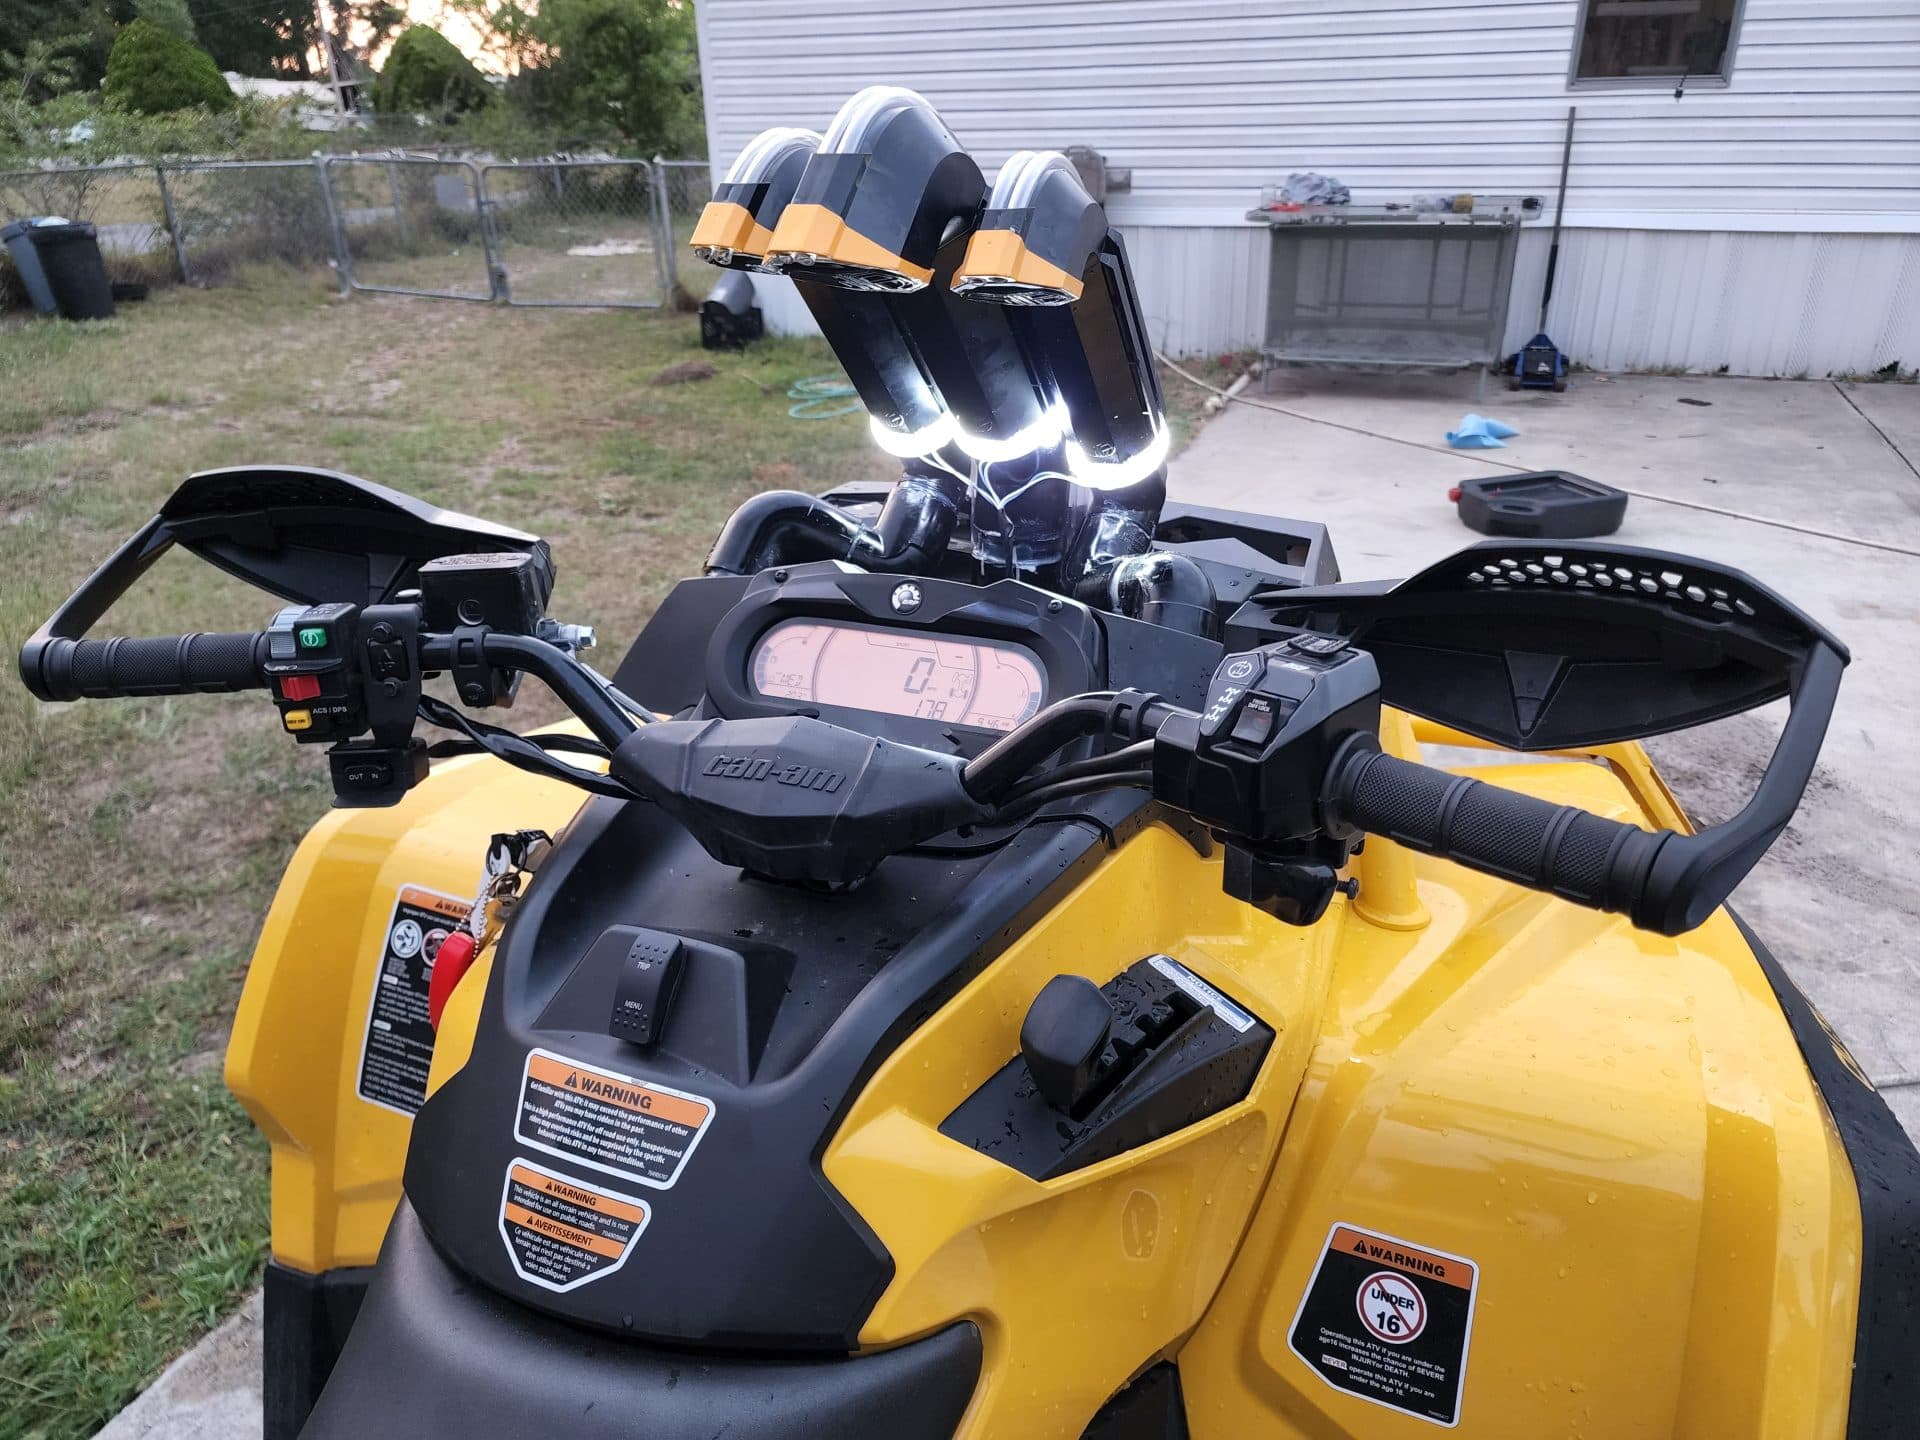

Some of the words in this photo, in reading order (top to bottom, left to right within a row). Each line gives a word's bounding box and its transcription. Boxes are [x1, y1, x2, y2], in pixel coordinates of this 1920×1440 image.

[904, 656, 936, 694] 0
[702, 754, 846, 793] can-am
[624, 999, 643, 1011] MENU
[582, 1078, 651, 1109] WARNING
[588, 1102, 600, 1111] may
[600, 1106, 618, 1116] exceed
[618, 1110, 628, 1119] the
[628, 1115, 664, 1129] performance
[672, 1127, 688, 1136] other
[621, 1122, 631, 1130] the
[572, 1140, 582, 1148] ATV
[577, 1121, 588, 1129] ATV
[603, 1129, 616, 1139] road
[616, 1134, 626, 1142] use
[641, 1140, 682, 1160] Inexperienced
[600, 1140, 626, 1152] surprised
[633, 1149, 643, 1157] the
[644, 1153, 665, 1163] specific
[554, 1185, 596, 1206] WARNING
[535, 1220, 592, 1245] AVERTISSEMENT
[578, 1211, 598, 1221] vehicle
[617, 1223, 629, 1231] not
[515, 1227, 521, 1235] Ce
[584, 1254, 597, 1263] tout
[1371, 1246, 1444, 1276] WARNING
[1371, 1288, 1415, 1311] UNDER
[1376, 1312, 1401, 1334] 16
[1321, 1327, 1351, 1343] Operating
[1366, 1343, 1380, 1351] ATV
[1414, 1359, 1433, 1368] under
[1323, 1355, 1346, 1369] NEVER
[1349, 1366, 1373, 1377] operate
[1375, 1374, 1387, 1382] this
[1389, 1378, 1403, 1387] ATV
[1410, 1386, 1423, 1394] you
[1339, 1342, 1369, 1356] increases
[1371, 1352, 1381, 1360] the
[1383, 1357, 1406, 1368] chance
[1417, 1367, 1444, 1381] SEVERE
[1349, 1374, 1368, 1383] under
[1370, 1380, 1380, 1388] the
